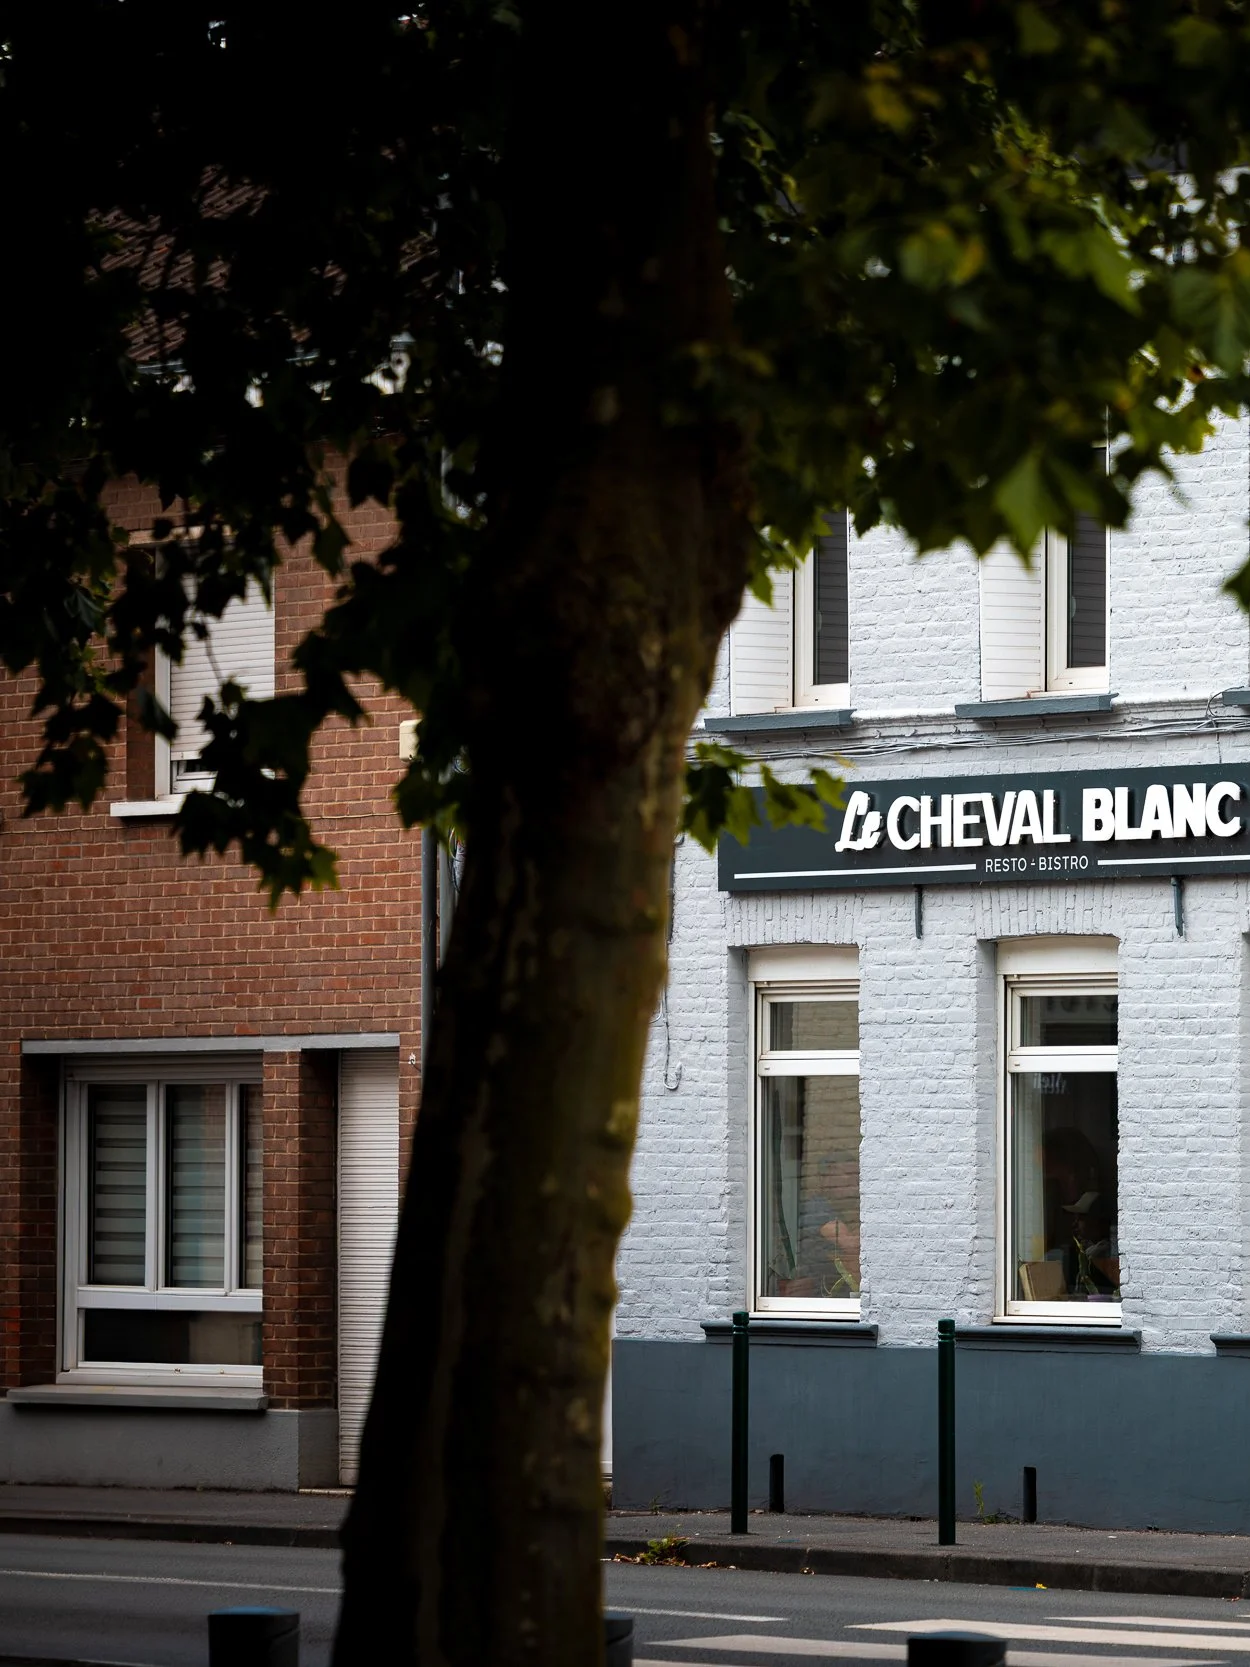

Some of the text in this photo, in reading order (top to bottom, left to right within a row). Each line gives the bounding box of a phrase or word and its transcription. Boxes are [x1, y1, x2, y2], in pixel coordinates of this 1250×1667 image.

[835, 781, 1241, 853] Le CHEVAL BLANC
[985, 858, 1027, 873] RESTO
[1038, 855, 1089, 871] BISTRO
